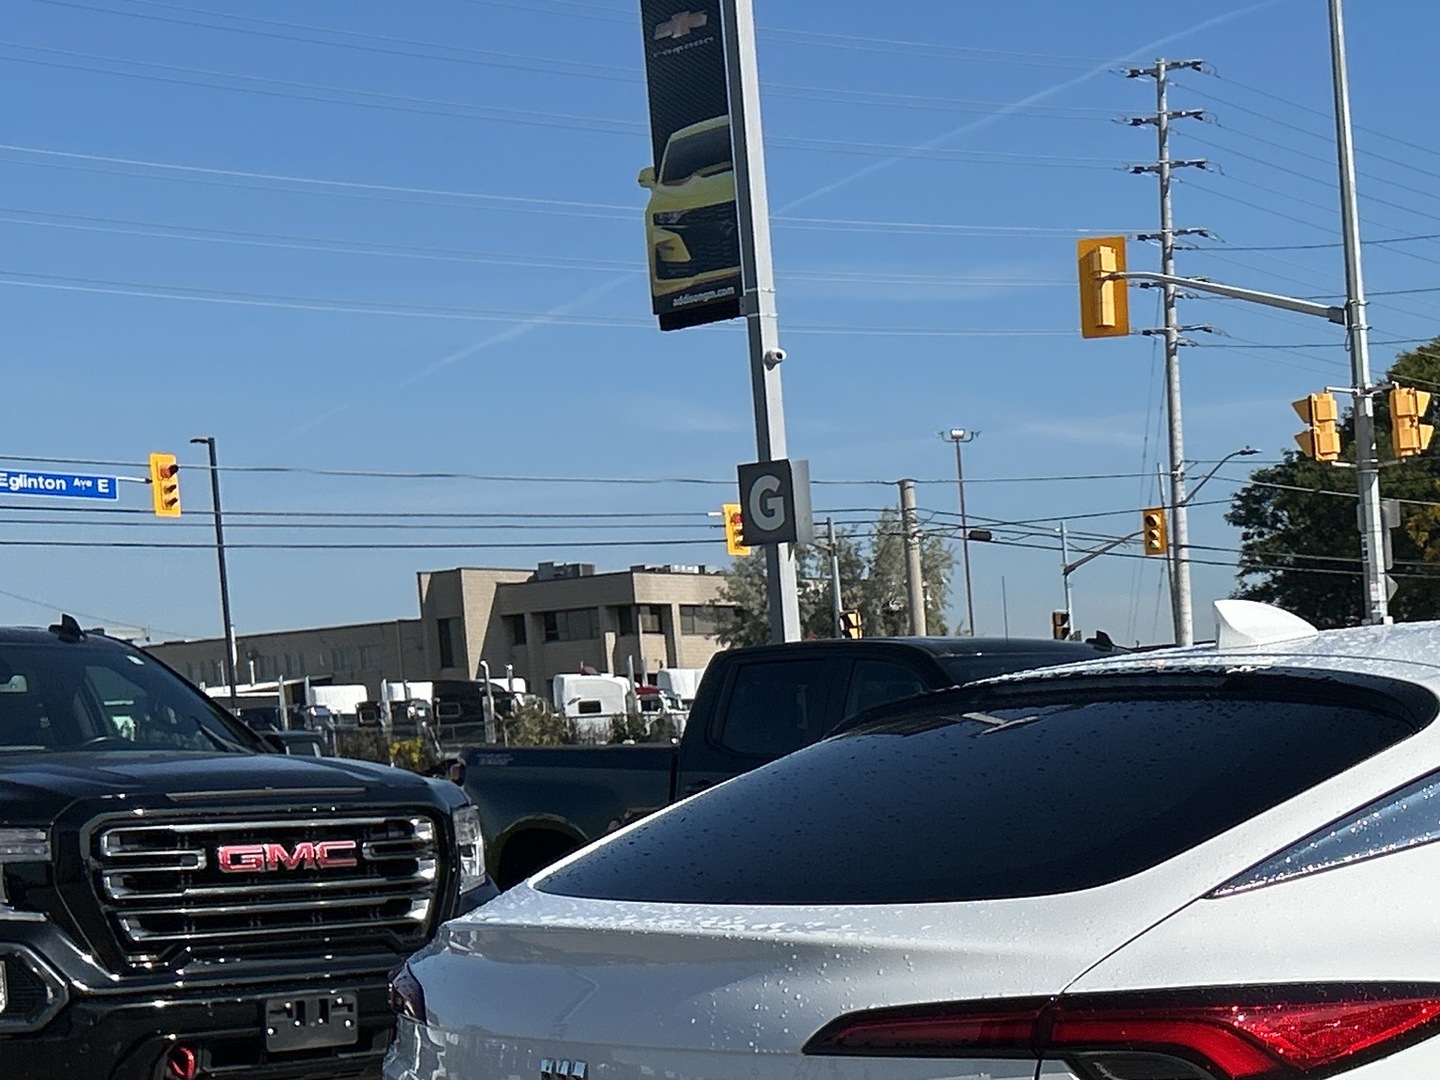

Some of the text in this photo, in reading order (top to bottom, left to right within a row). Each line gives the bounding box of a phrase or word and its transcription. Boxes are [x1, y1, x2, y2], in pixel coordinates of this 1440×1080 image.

[0, 473, 66, 491] Eglinton
[98, 479, 109, 493] E
[749, 474, 785, 531] G
[217, 840, 357, 873] GMC
